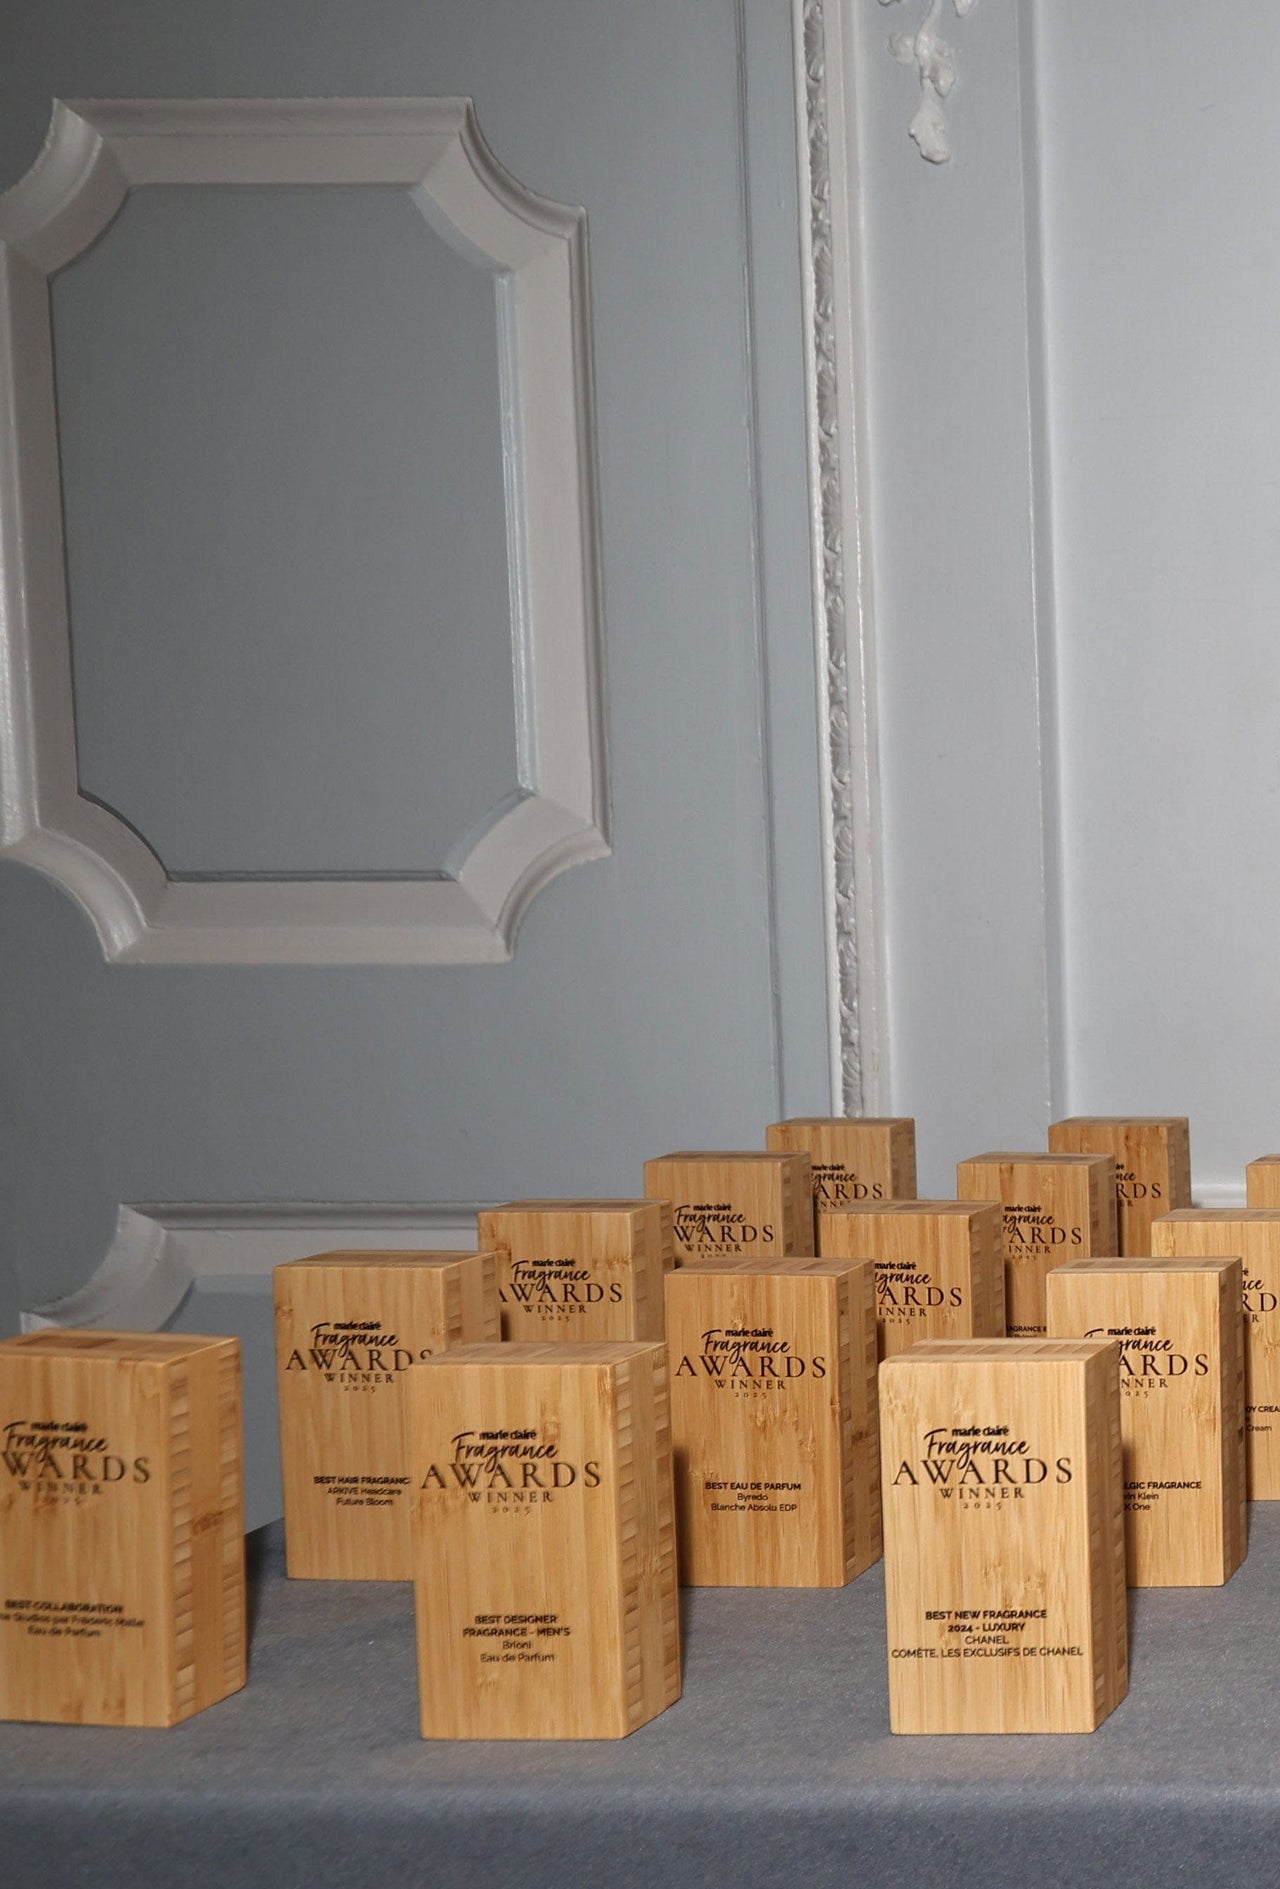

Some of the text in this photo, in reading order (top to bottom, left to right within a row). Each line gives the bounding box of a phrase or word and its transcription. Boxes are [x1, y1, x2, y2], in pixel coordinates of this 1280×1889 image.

[674, 1205, 746, 1232] Fragrance
[511, 1260, 591, 1291] Fragrance
[523, 1305, 586, 1313] WINNER
[311, 1323, 399, 1357] Fragrance
[702, 1330, 790, 1364] Fragrance
[675, 1356, 826, 1378] AWARDS
[324, 1373, 394, 1383] WINNER
[714, 1380, 786, 1390] WINNER
[3, 1421, 108, 1462] Fragrance
[452, 1432, 558, 1473] Fragrance
[924, 1429, 1029, 1469] Fragrance
[421, 1462, 600, 1488] AWARDS
[892, 1458, 1072, 1485] AWARDS
[706, 1482, 727, 1490] BEST
[469, 1492, 553, 1503] WINNER
[738, 1494, 768, 1502] Byredo
[940, 1488, 1025, 1499] WINNER
[492, 1506, 530, 1515] 2025
[964, 1502, 1001, 1510] 2025
[926, 1610, 1047, 1619] BEST NEW FRAGRANCE
[475, 1616, 557, 1624] BEST DESIGNER
[463, 1629, 527, 1637] FRAGRANCE
[948, 1623, 1025, 1633] 2024 LUXURY
[503, 1641, 531, 1649] Brioni
[965, 1636, 1009, 1644] CHANEL
[942, 1649, 960, 1657] LES
[963, 1648, 1020, 1657] EXCLUSIFS
[1023, 1648, 1037, 1656] DE
[1040, 1647, 1083, 1656] CHANEL
[481, 1654, 499, 1662] Eau
[503, 1654, 516, 1662] de
